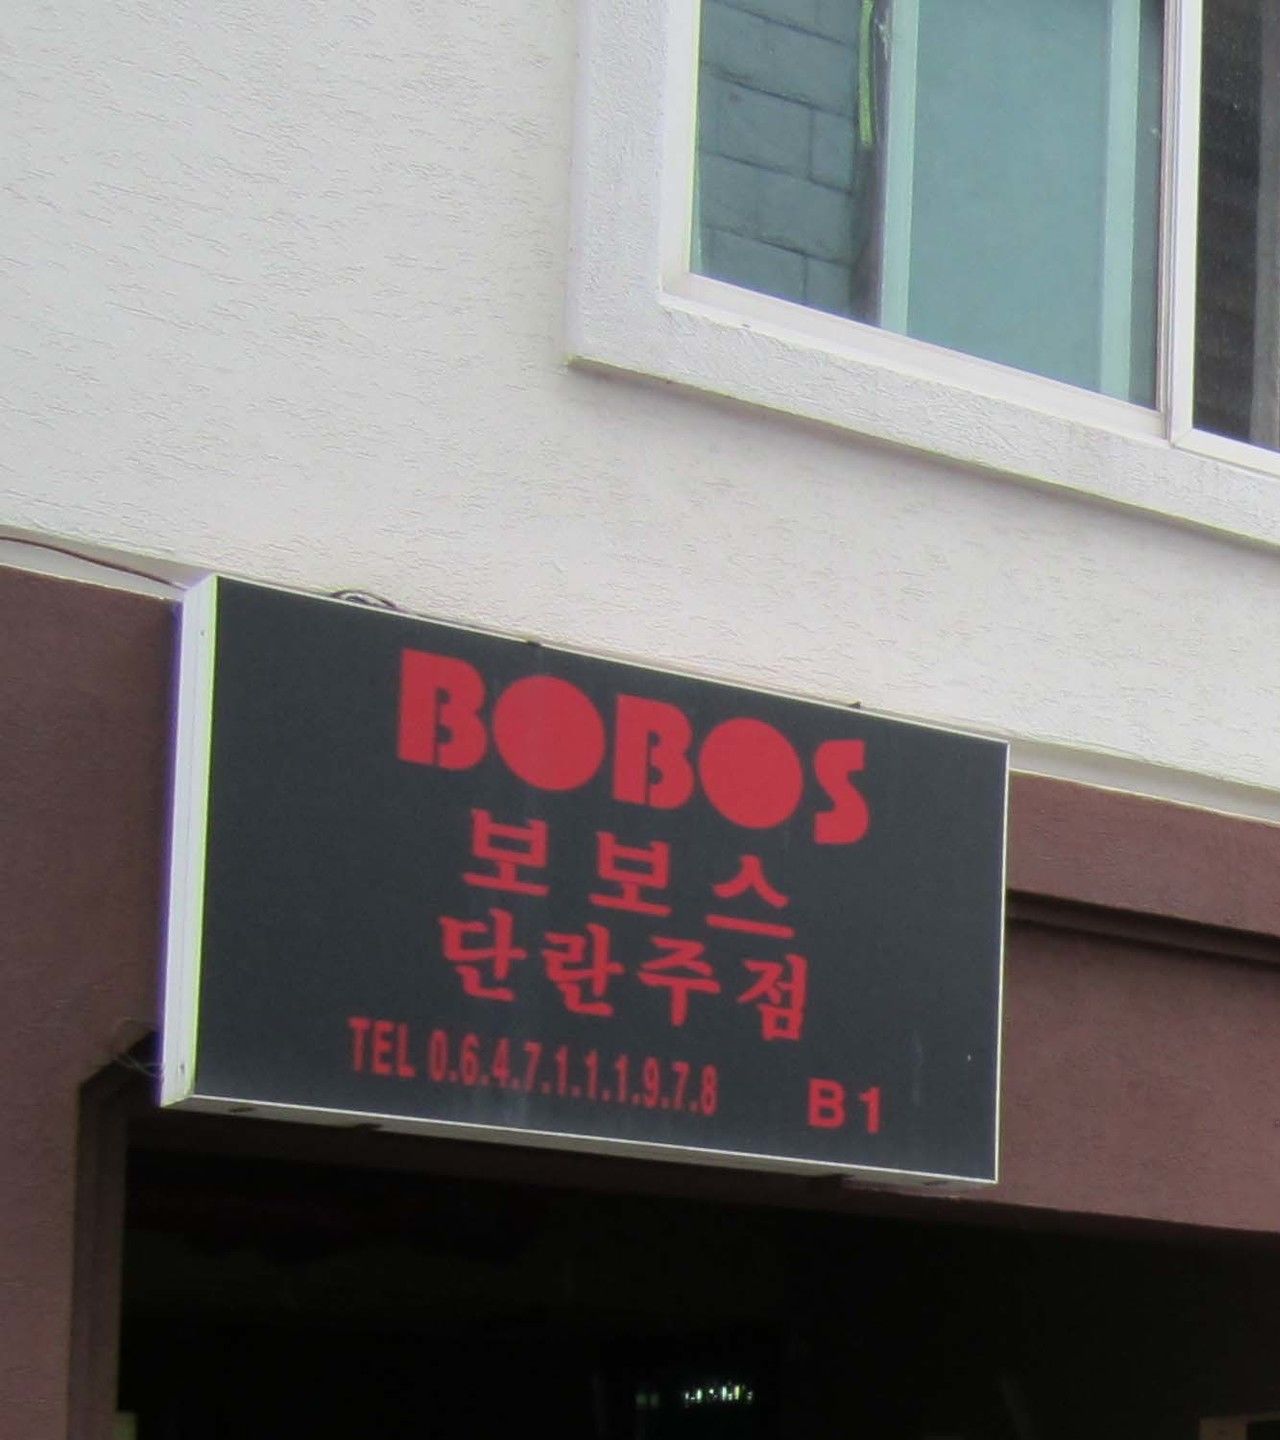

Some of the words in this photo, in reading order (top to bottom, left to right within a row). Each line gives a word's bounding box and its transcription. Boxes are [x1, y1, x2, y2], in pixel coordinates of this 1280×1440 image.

[398, 648, 870, 845] BOBOS
[463, 808, 795, 939] 보보스
[439, 907, 808, 1041] 단란주점
[349, 1017, 415, 1079] TEL
